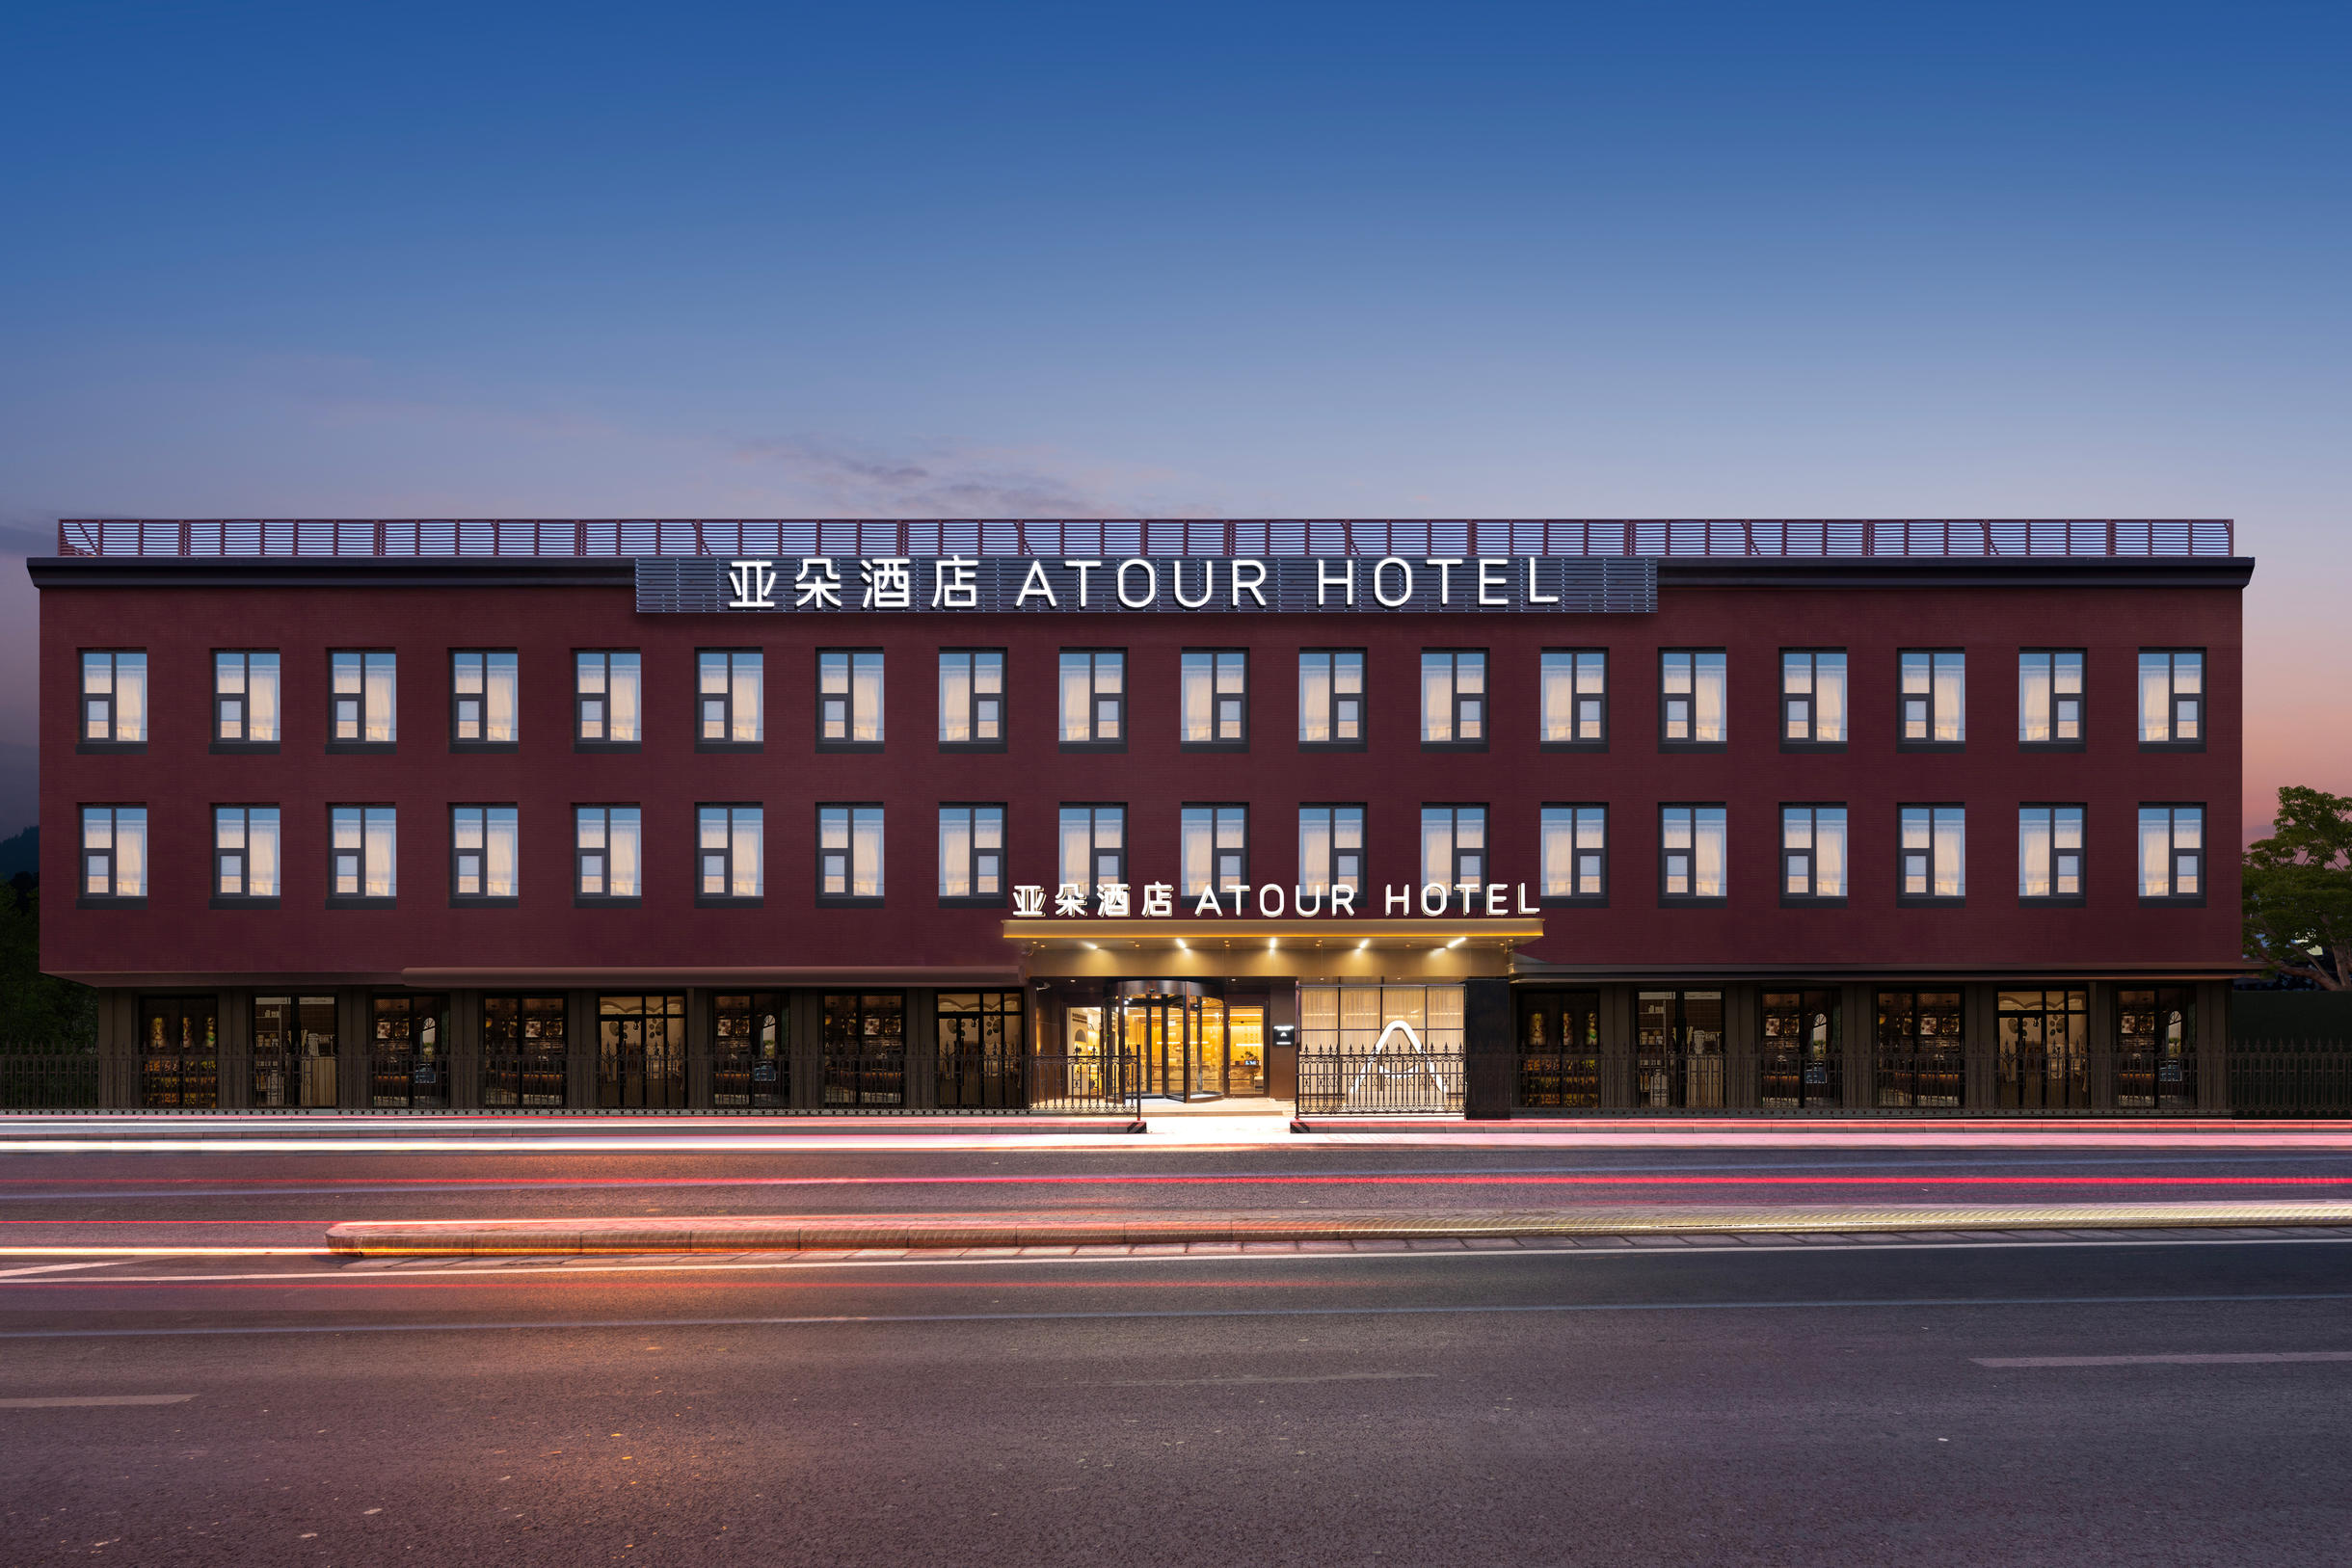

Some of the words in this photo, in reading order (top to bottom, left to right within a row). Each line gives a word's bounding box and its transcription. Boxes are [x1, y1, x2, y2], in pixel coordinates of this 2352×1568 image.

[728, 554, 979, 609] 亚朵酒店
[1014, 555, 1269, 608] ATOUR
[1316, 555, 1561, 609] HOTEL
[1012, 882, 1173, 917] 亚朵酒店
[1194, 884, 1355, 917] ATOUR
[1385, 882, 1541, 917] HOTEL
